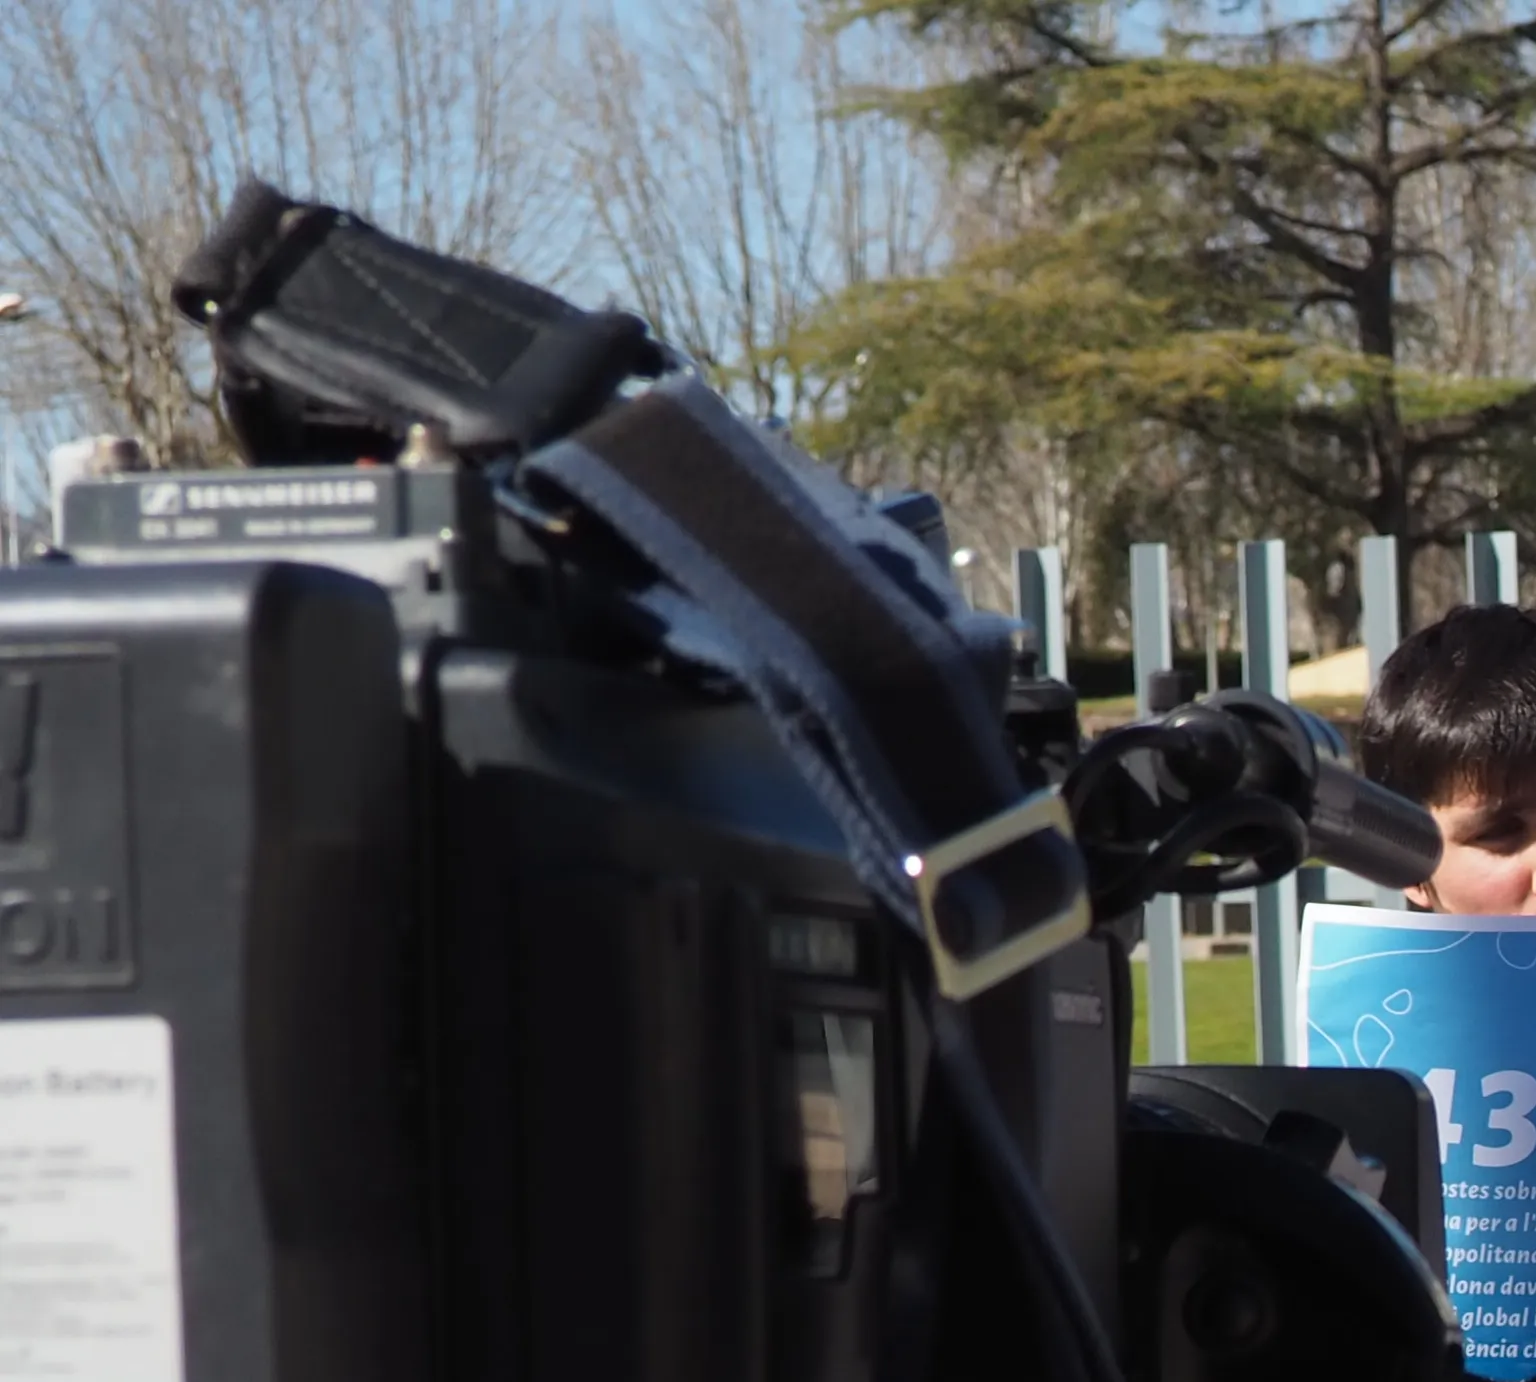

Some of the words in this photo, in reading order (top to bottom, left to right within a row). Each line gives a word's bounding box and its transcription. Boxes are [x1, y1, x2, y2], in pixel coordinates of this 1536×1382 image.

[1465, 1216, 1500, 1236] per
[1505, 1216, 1518, 1232] a
[1449, 1273, 1495, 1296] lona
[1461, 1305, 1529, 1331] global
[1465, 1336, 1519, 1358] ència
